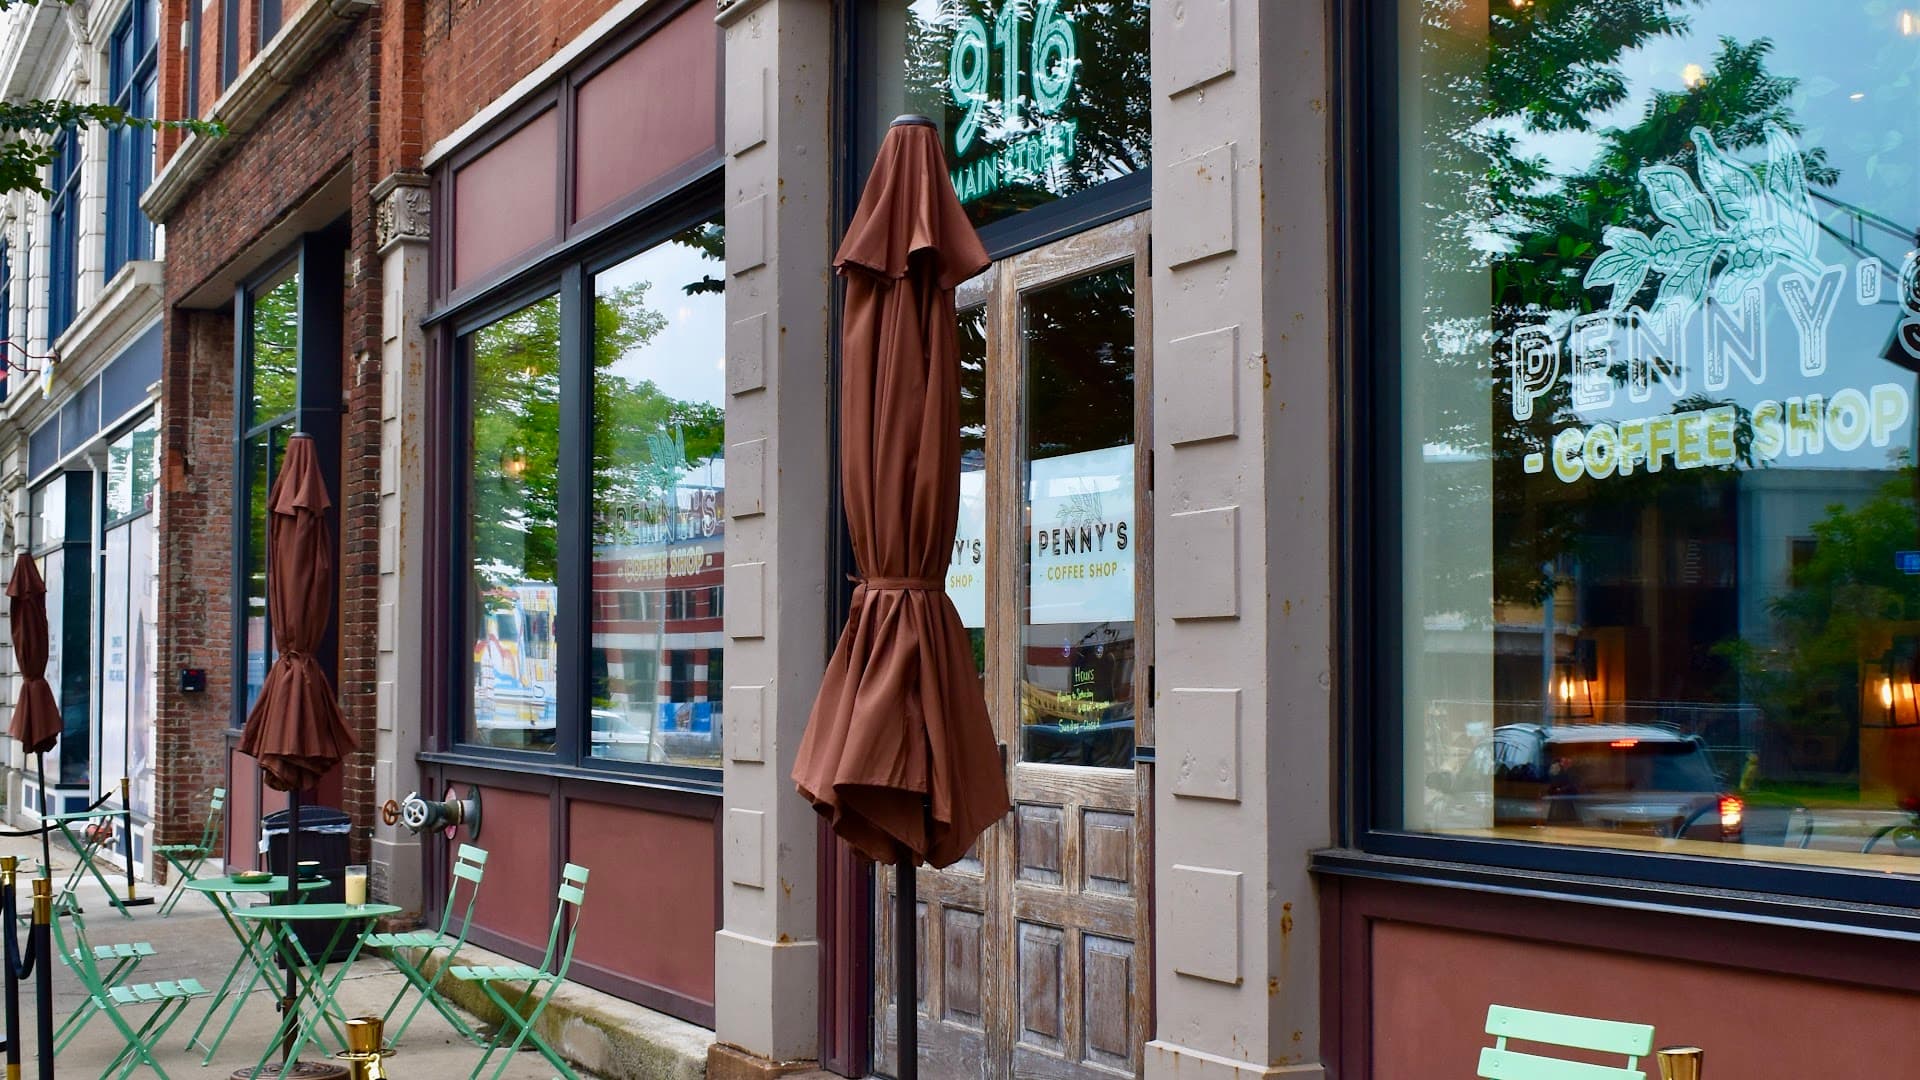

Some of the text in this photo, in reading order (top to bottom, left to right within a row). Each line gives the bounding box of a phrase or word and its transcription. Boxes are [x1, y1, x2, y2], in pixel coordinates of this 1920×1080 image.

[950, 0, 1076, 157] 916
[951, 118, 1078, 200] MAIN STREET
[1751, 383, 1909, 459] SHOP
[1038, 521, 1128, 558] PENNY'S
[669, 545, 704, 577] SHOP
[1047, 562, 1118, 581] COFFEE SHOP
[950, 575, 973, 588] SHOP
[1074, 666, 1095, 682] Hours
